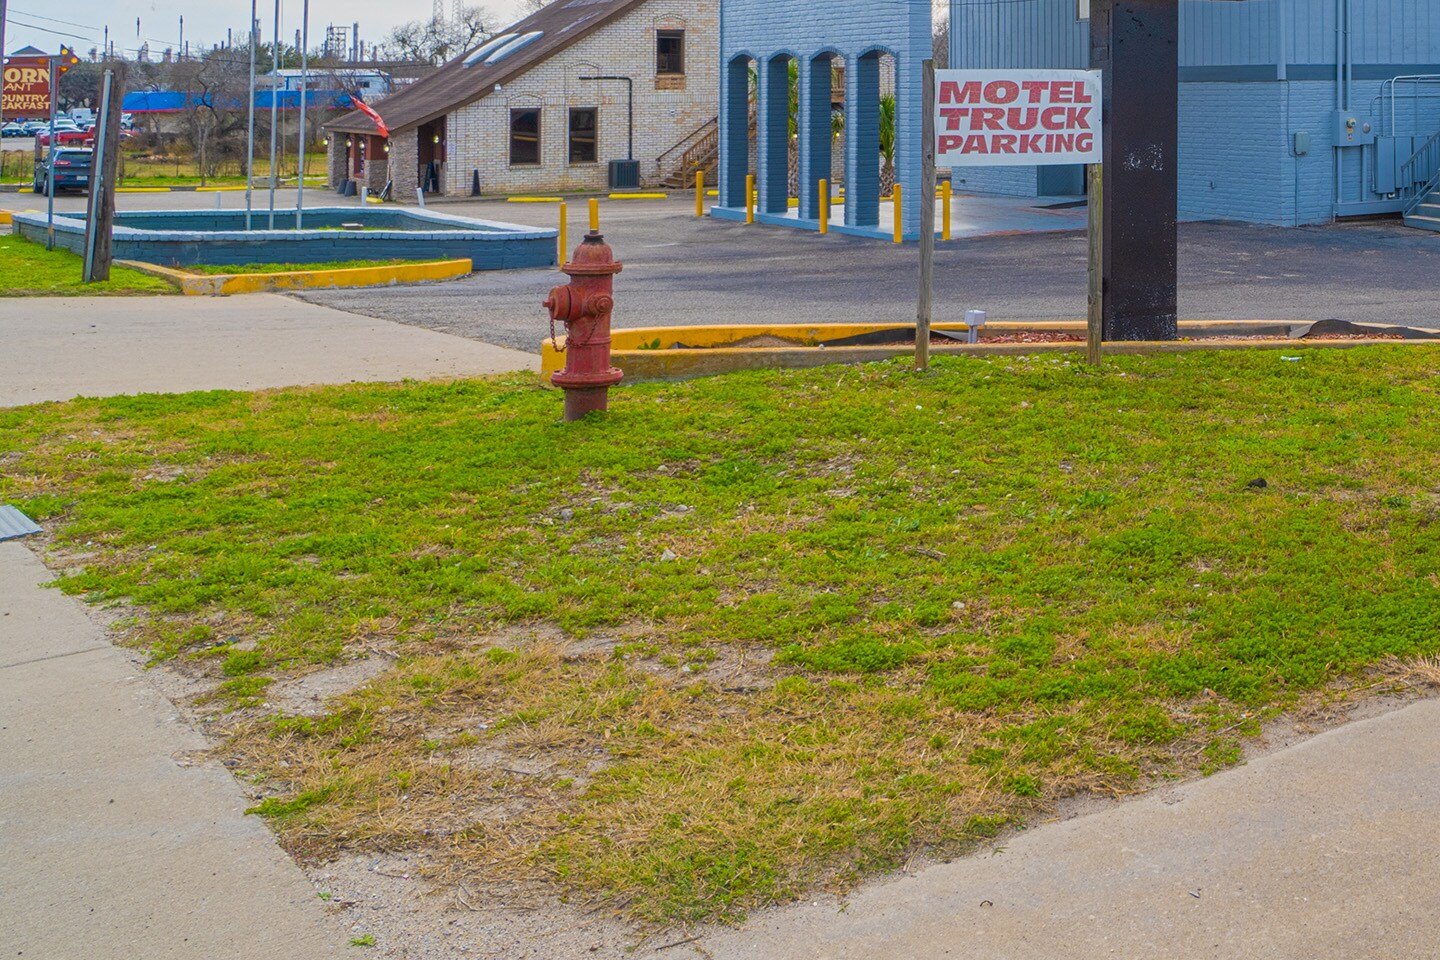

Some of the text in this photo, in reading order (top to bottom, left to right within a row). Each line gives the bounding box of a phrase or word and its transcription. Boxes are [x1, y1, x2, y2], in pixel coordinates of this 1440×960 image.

[938, 80, 1092, 105] MOTEL
[939, 106, 1093, 132] TRUCK
[938, 132, 1094, 155] PARKING
